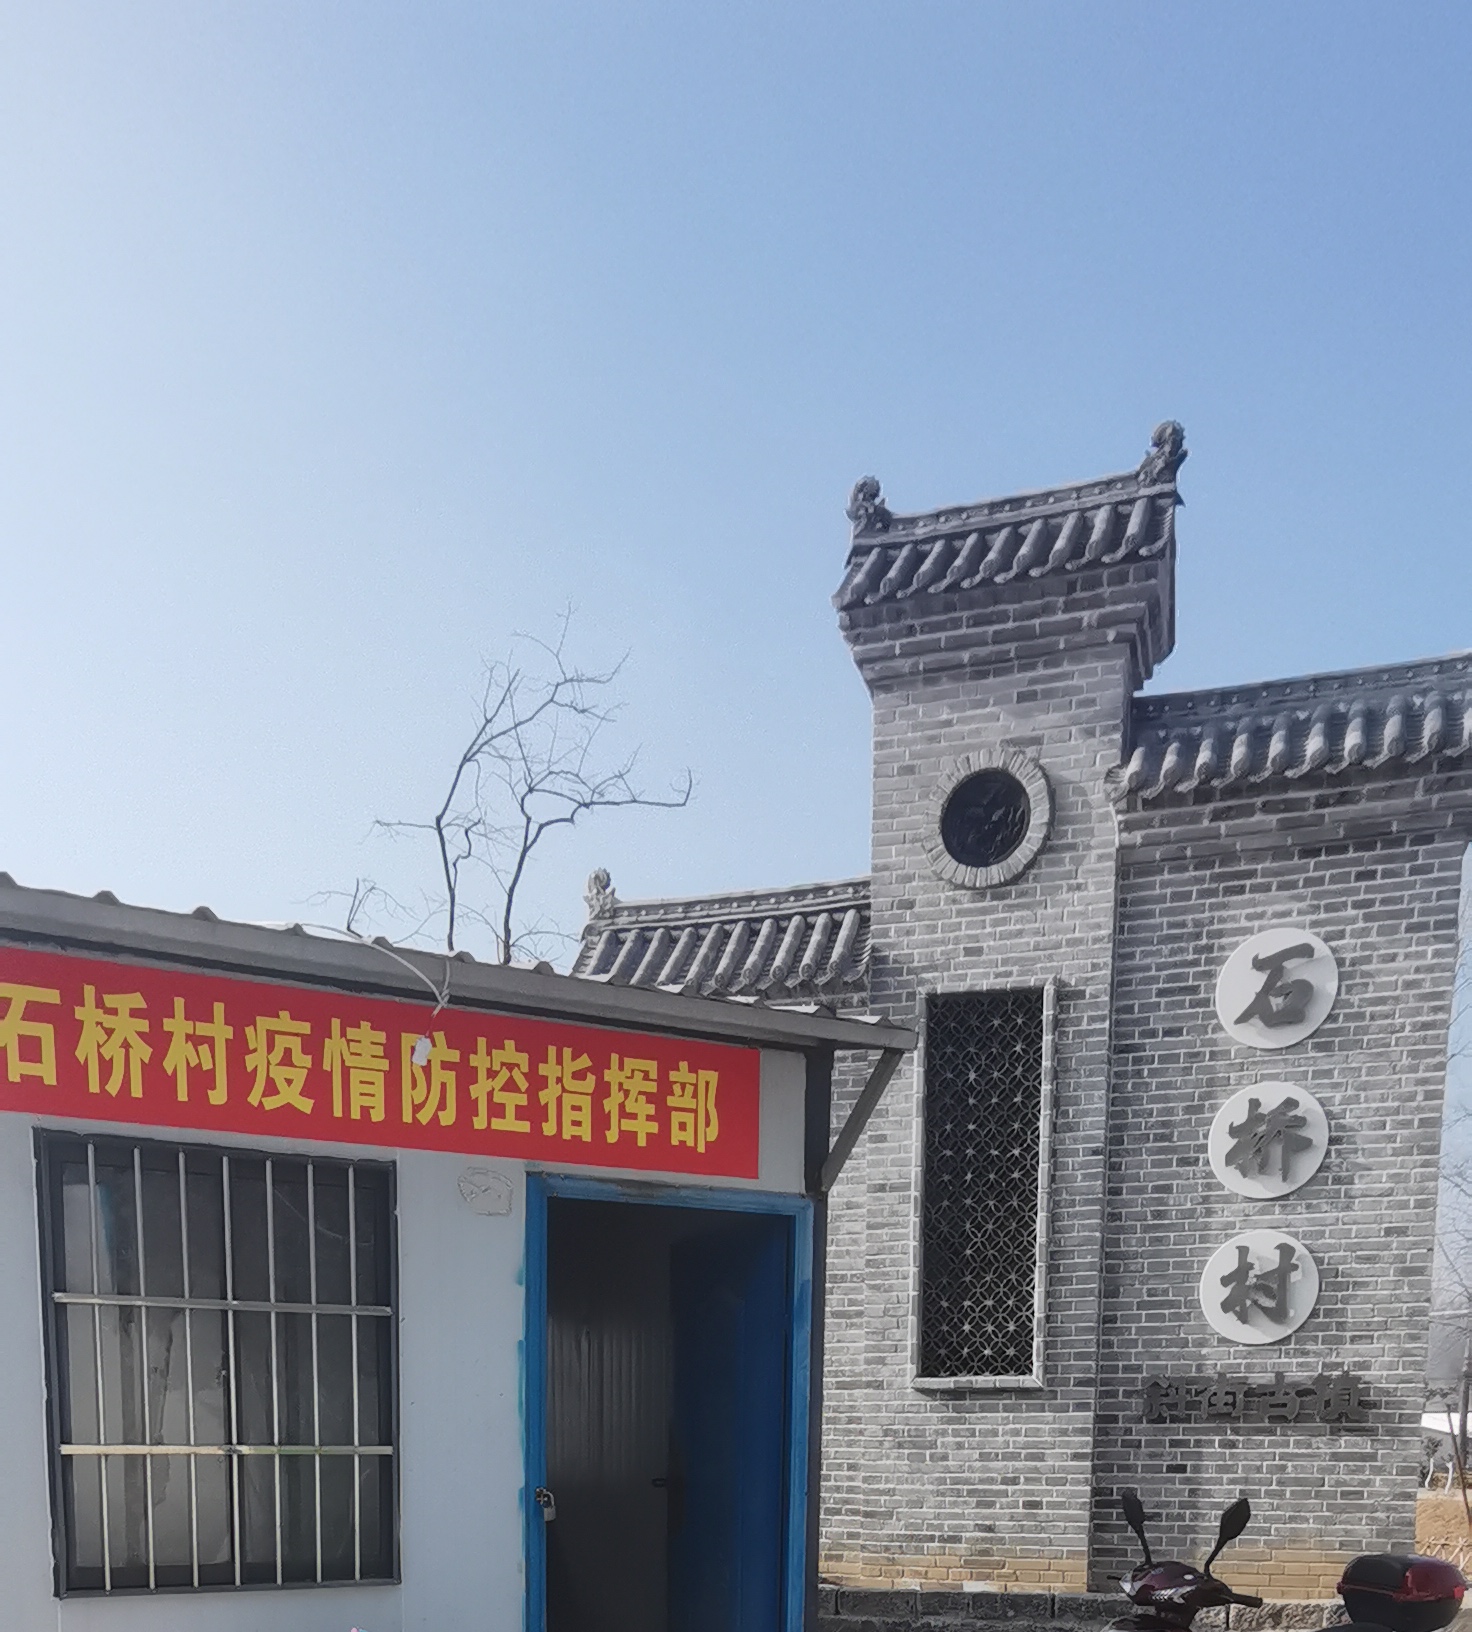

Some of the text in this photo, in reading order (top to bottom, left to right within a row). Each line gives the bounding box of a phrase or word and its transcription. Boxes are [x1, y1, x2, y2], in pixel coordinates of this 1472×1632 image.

[0, 982, 721, 1154] 石桥村疫情防控指挥部
